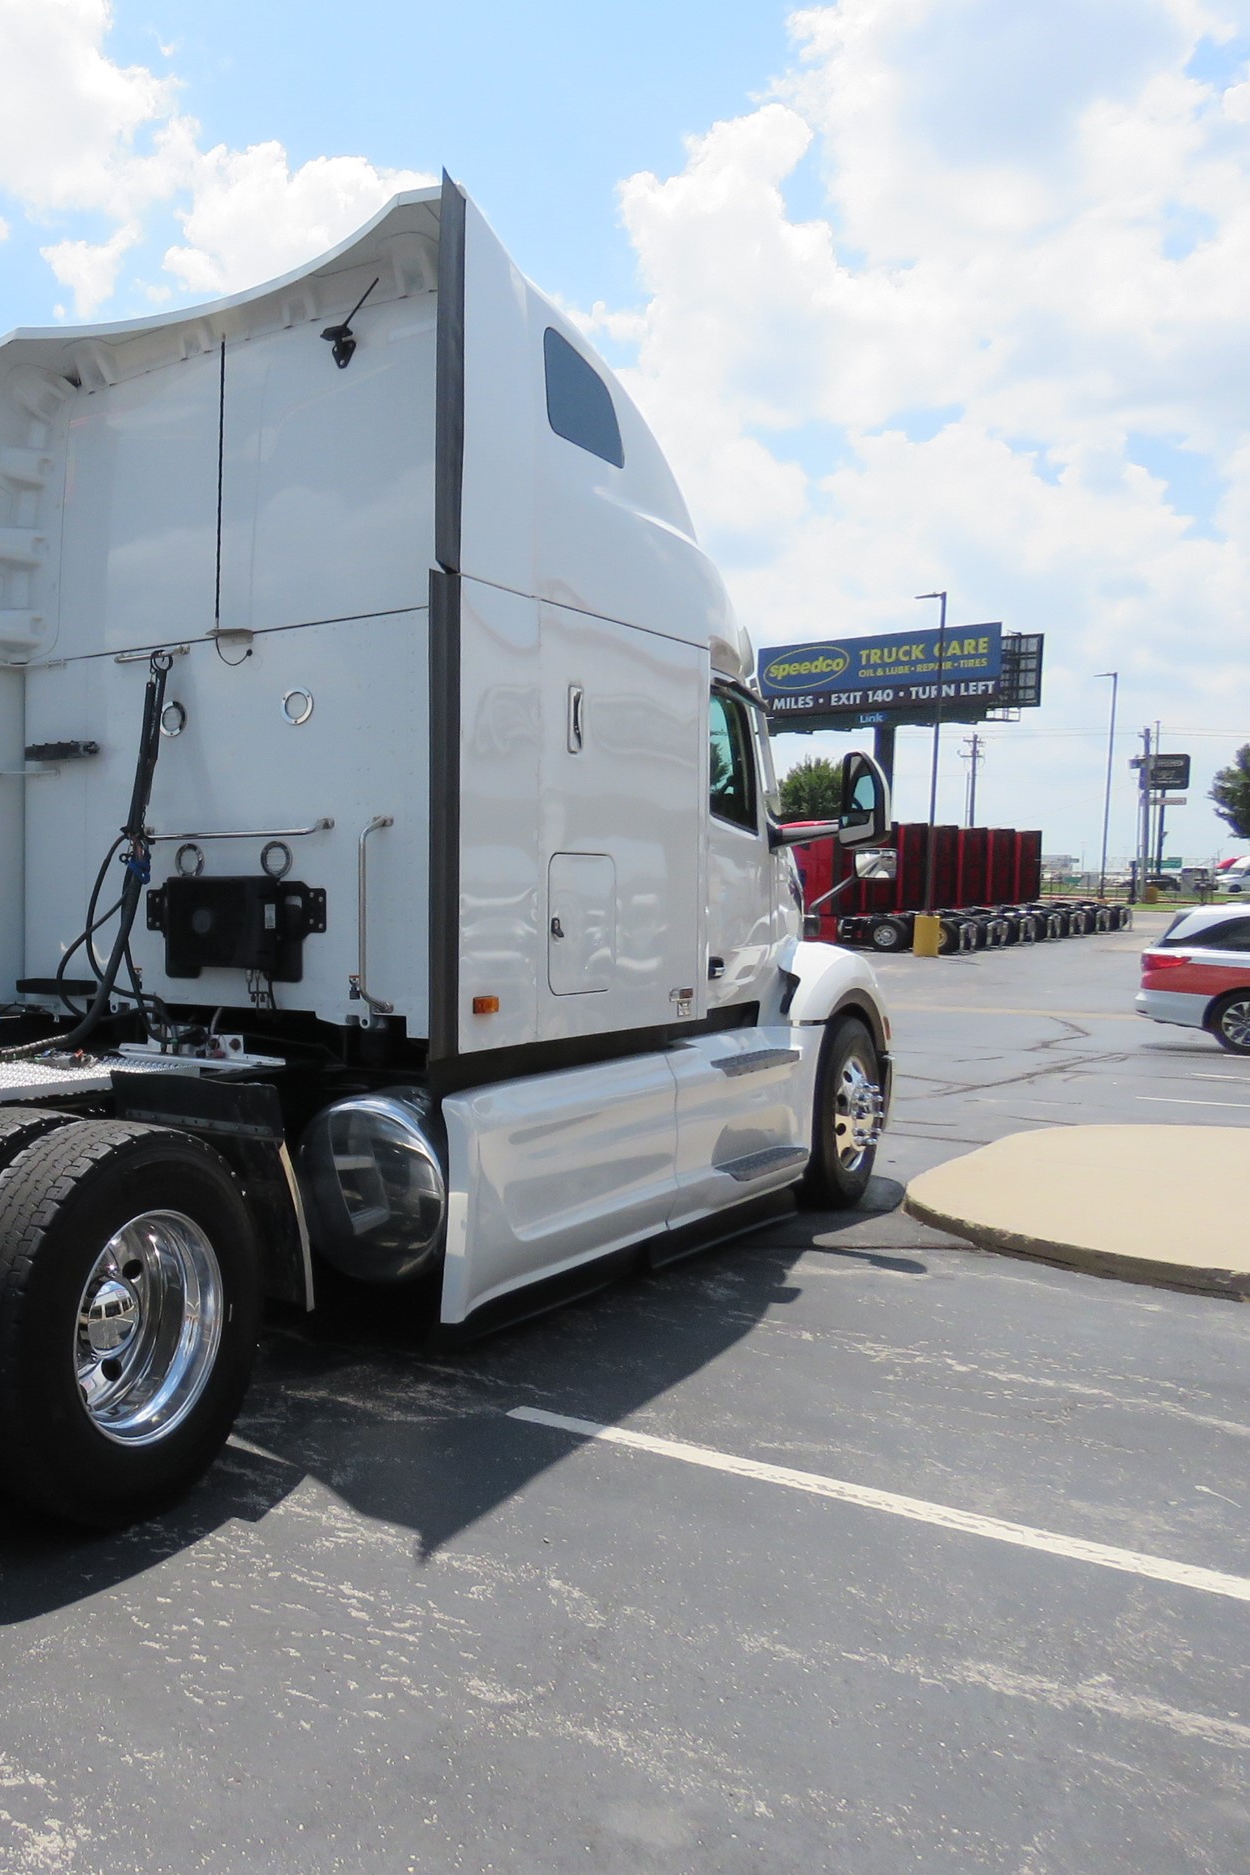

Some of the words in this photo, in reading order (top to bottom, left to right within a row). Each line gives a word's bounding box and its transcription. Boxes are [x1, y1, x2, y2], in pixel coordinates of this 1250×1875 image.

[859, 643, 926, 665] TRUCK
[933, 637, 990, 657] CARE
[768, 655, 845, 680] speedco
[858, 668, 876, 678] OIL
[876, 667, 885, 677] &
[886, 665, 910, 676] LUBE
[959, 658, 988, 669] TIRES
[773, 696, 814, 711] MILES
[831, 691, 862, 706] EXIT
[867, 688, 894, 703] 140
[960, 681, 996, 696] LEFT
[859, 713, 885, 723] Link
